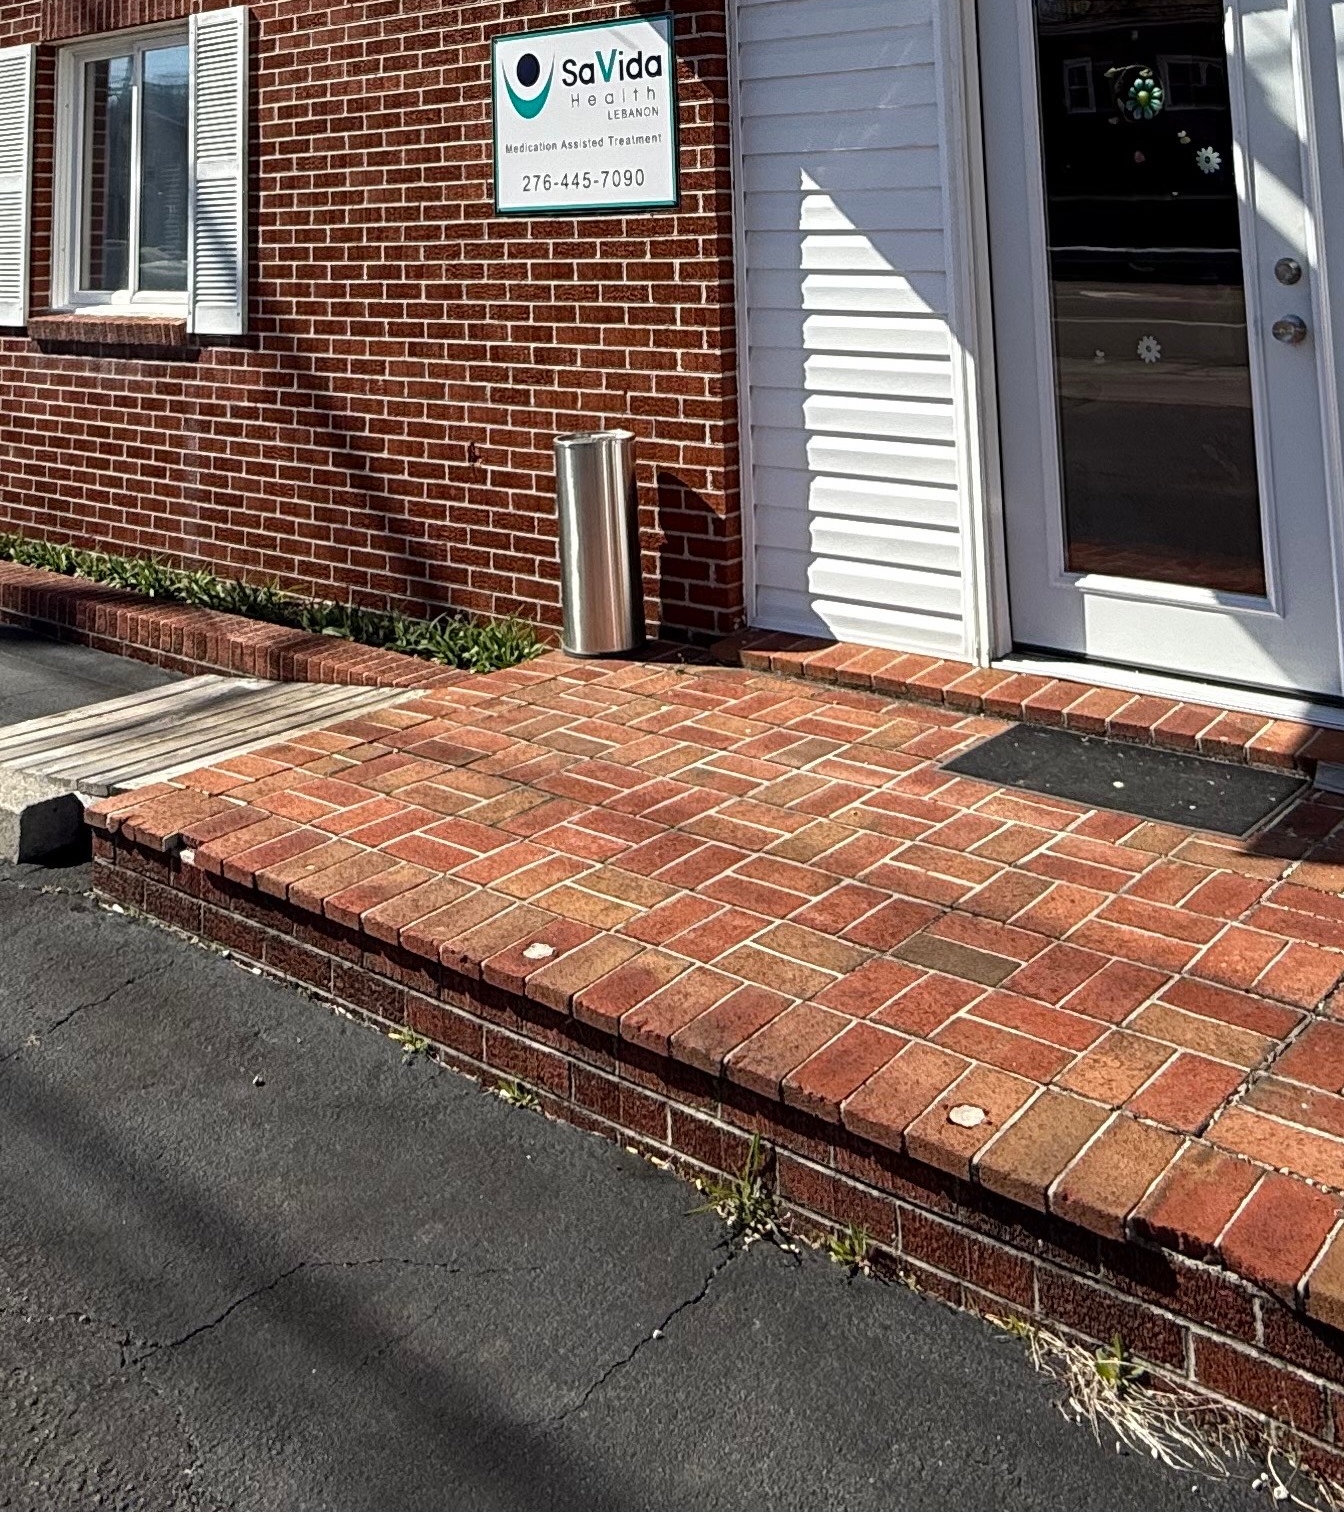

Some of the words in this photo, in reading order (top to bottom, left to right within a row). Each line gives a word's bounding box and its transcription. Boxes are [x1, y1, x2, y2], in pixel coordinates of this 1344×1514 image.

[562, 49, 662, 86] SaVida
[571, 86, 656, 108] Health
[608, 106, 659, 120] LEBANON
[506, 141, 557, 154] Medication
[561, 137, 604, 150] Assisted
[608, 134, 662, 147] Treatment
[523, 169, 645, 192] 276-445-7090
